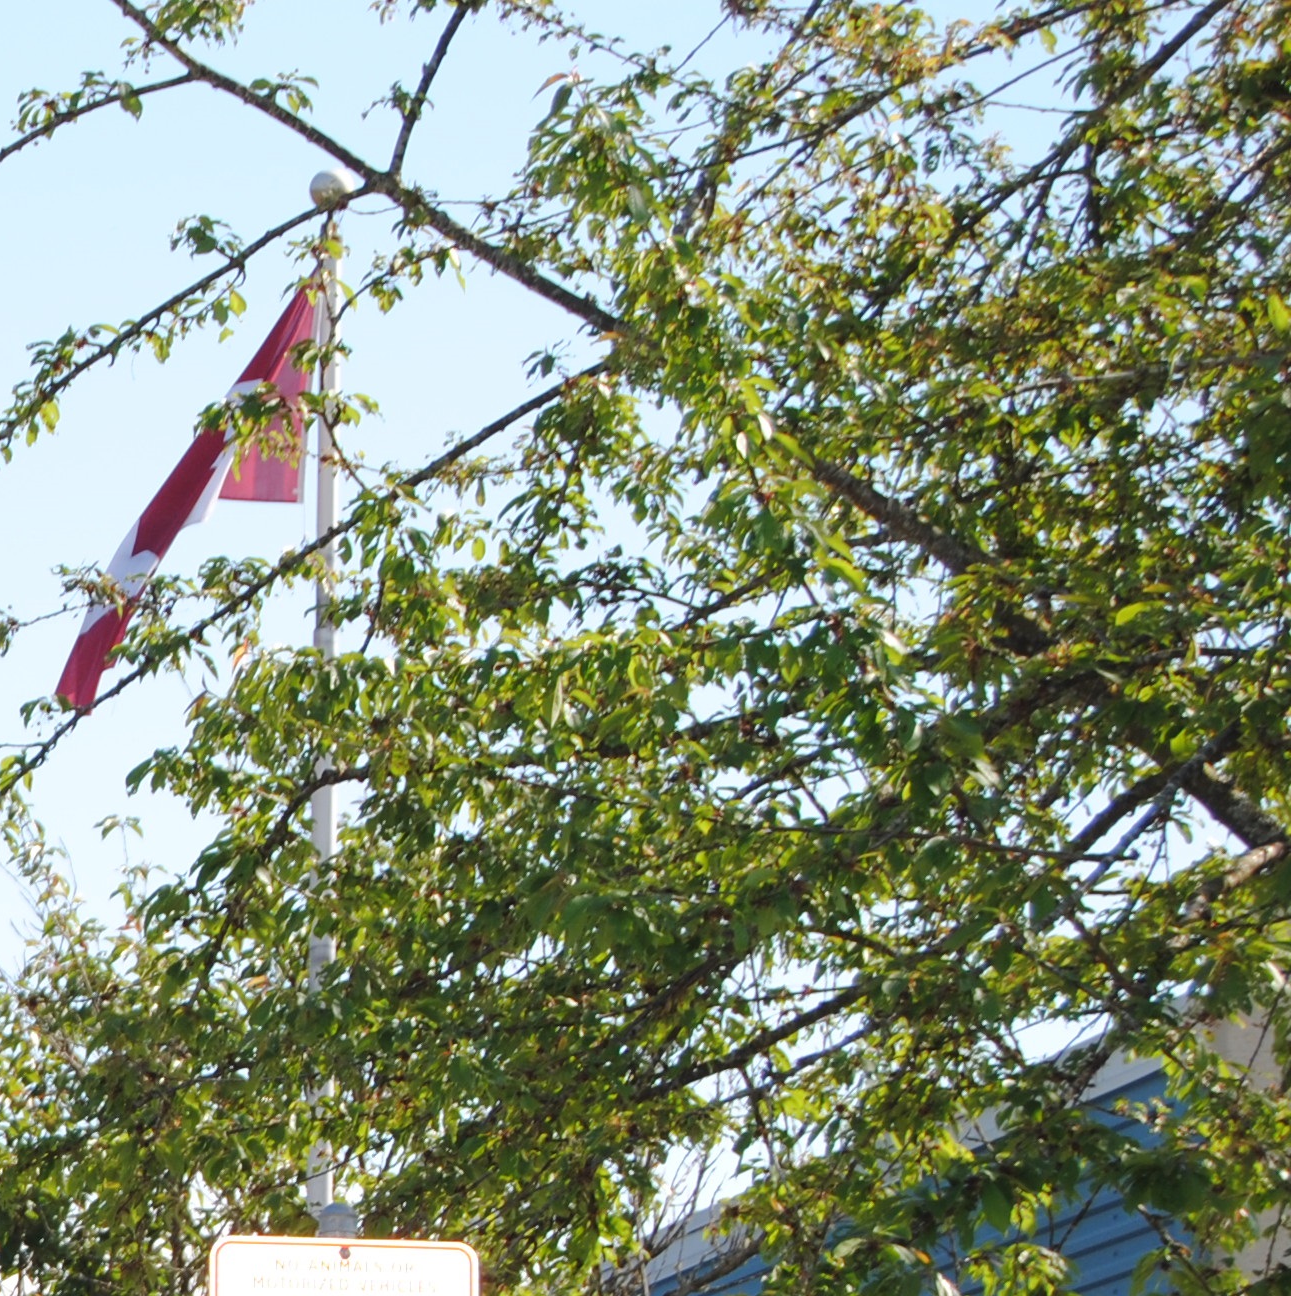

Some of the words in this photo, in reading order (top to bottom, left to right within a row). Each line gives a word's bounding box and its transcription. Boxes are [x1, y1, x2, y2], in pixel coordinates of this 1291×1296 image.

[308, 1258, 383, 1273] ANIMALS
[252, 1275, 350, 1291] MOTORIZED
[358, 1279, 438, 1294] VEHICLES
